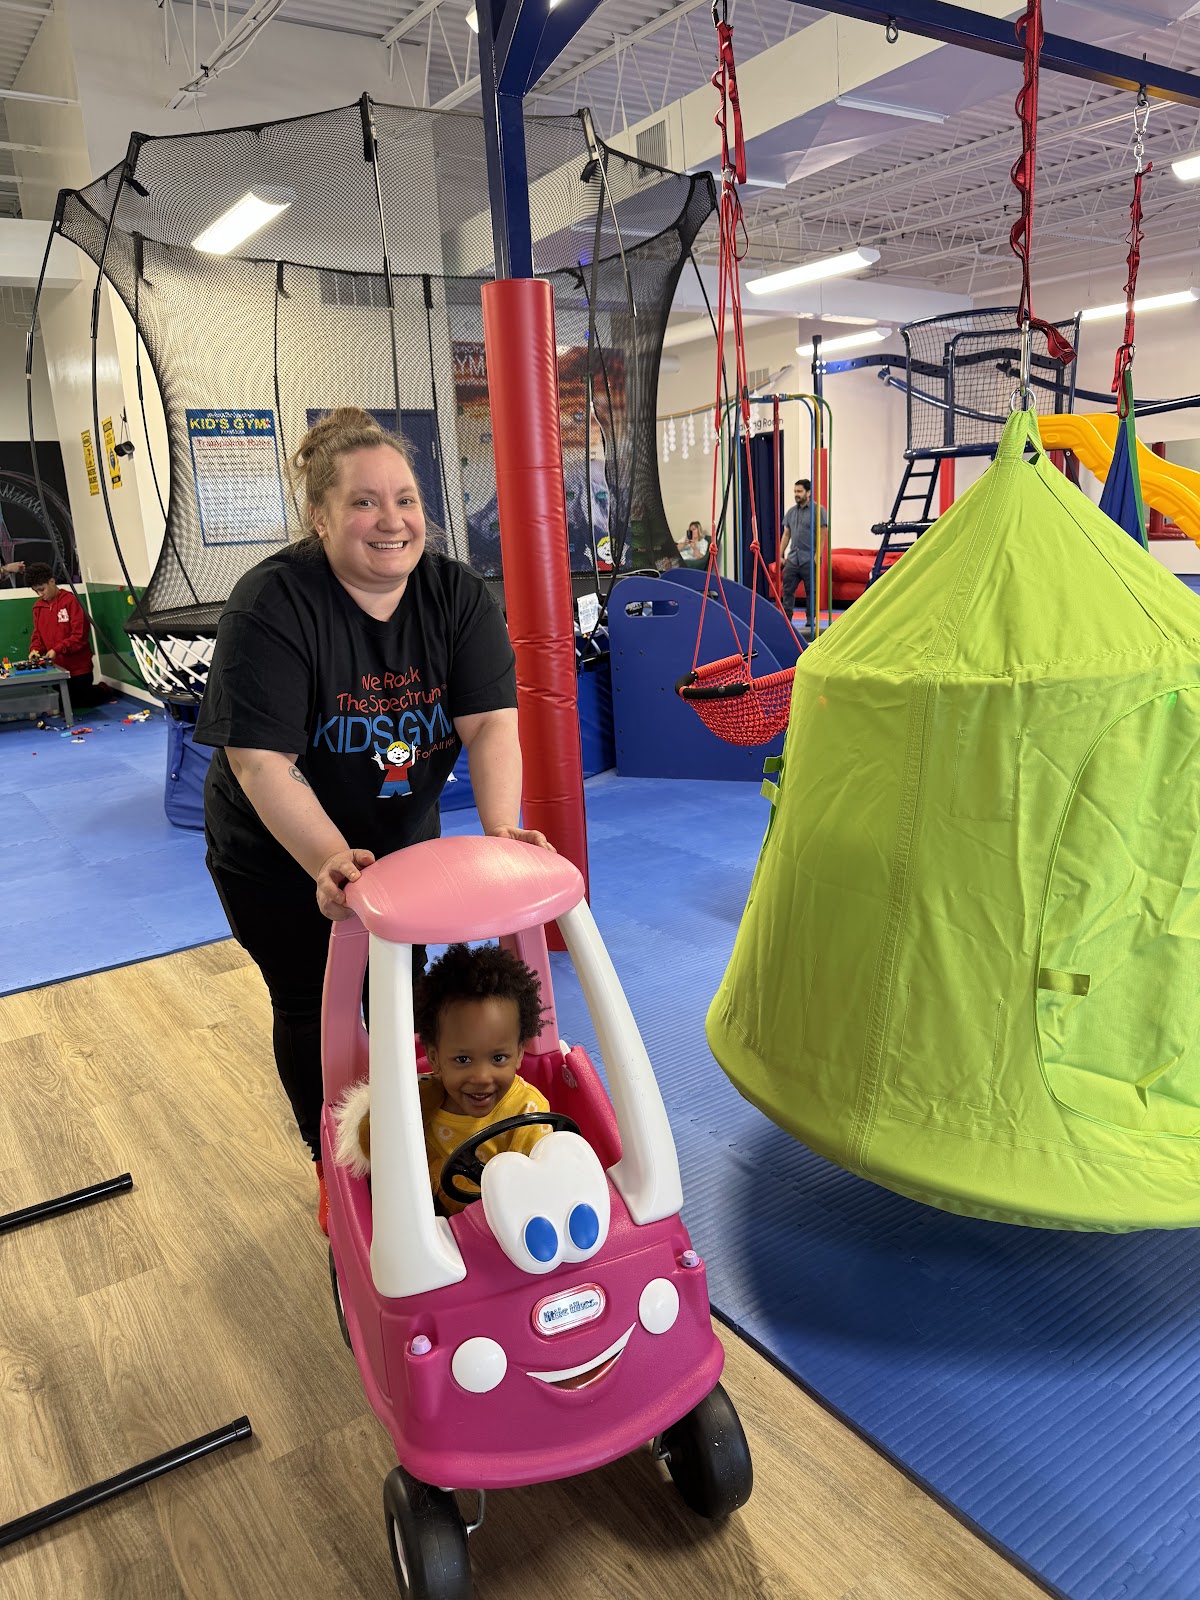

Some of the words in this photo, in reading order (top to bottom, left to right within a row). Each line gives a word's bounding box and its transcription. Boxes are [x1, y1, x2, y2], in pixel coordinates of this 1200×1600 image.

[190, 418, 229, 430] KID'S
[233, 418, 267, 430] GYM
[384, 666, 421, 689] Rock
[313, 711, 394, 755] KID'S
